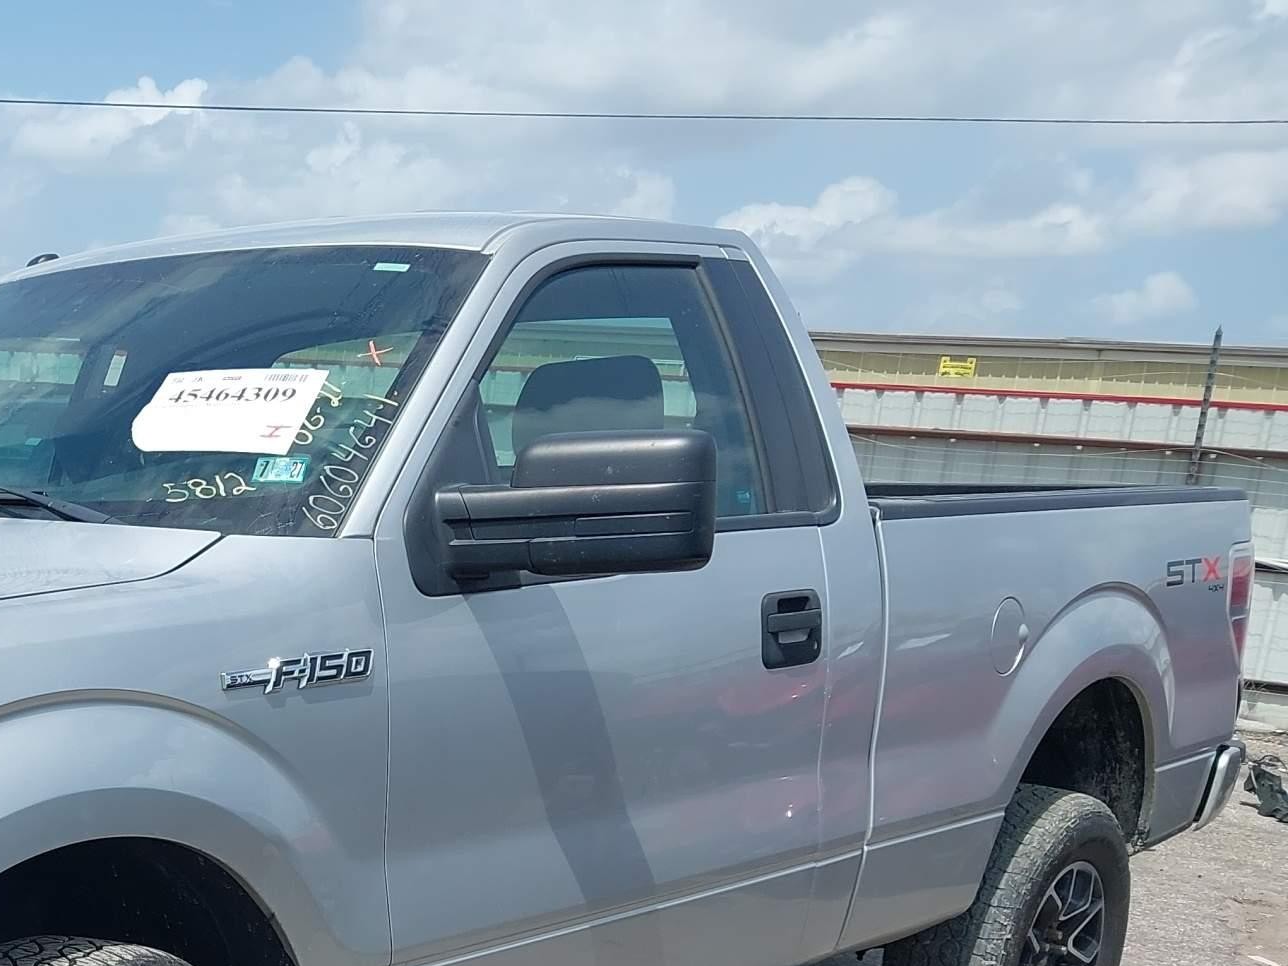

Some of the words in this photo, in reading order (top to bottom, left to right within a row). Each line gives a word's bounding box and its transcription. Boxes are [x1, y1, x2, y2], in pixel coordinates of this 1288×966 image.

[168, 386, 298, 405] 45464309
[259, 460, 271, 478] 7
[289, 461, 305, 479] 27
[162, 472, 257, 503] 5812
[1166, 555, 1223, 588] STX
[228, 674, 253, 685] STX
